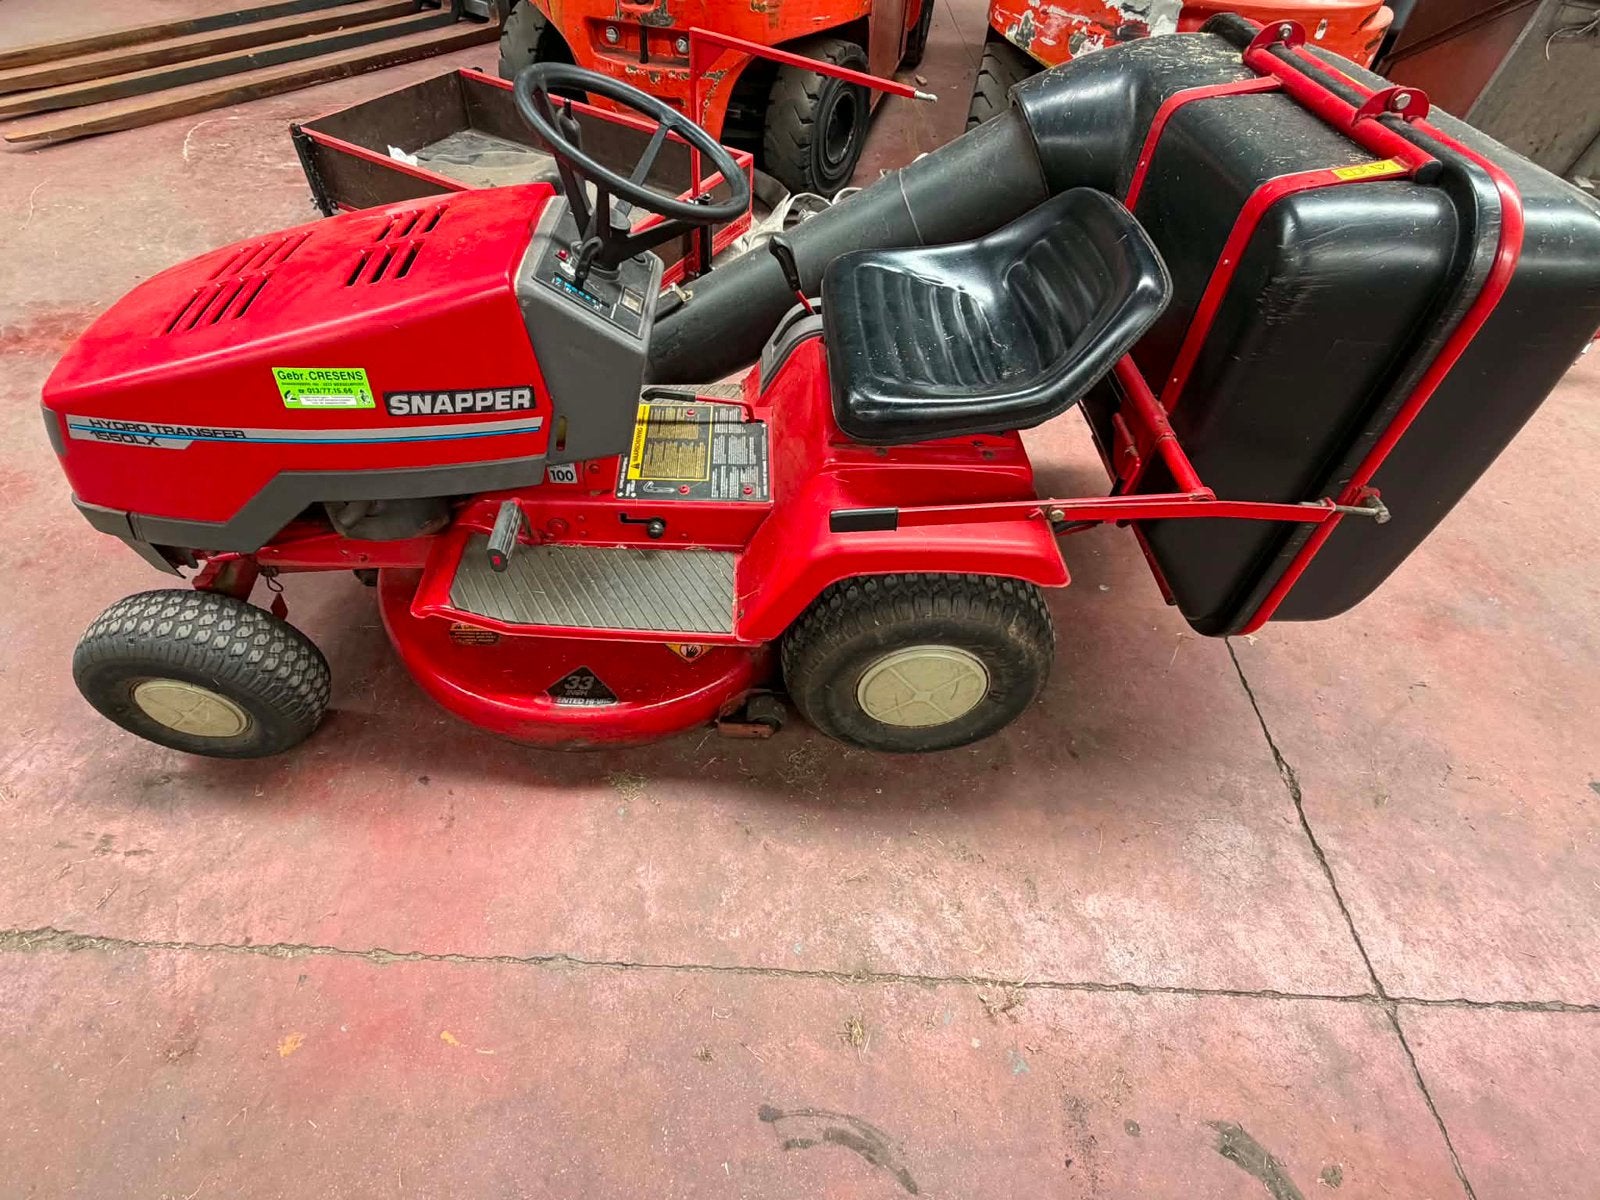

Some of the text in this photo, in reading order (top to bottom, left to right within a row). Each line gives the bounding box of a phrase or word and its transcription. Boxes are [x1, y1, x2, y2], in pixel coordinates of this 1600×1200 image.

[277, 370, 363, 381] Gebr. CRESENS
[389, 387, 532, 415] SNAPPER
[89, 418, 247, 438] HYDRO TRANSFER
[550, 469, 574, 481] 100
[564, 675, 595, 690] 33
